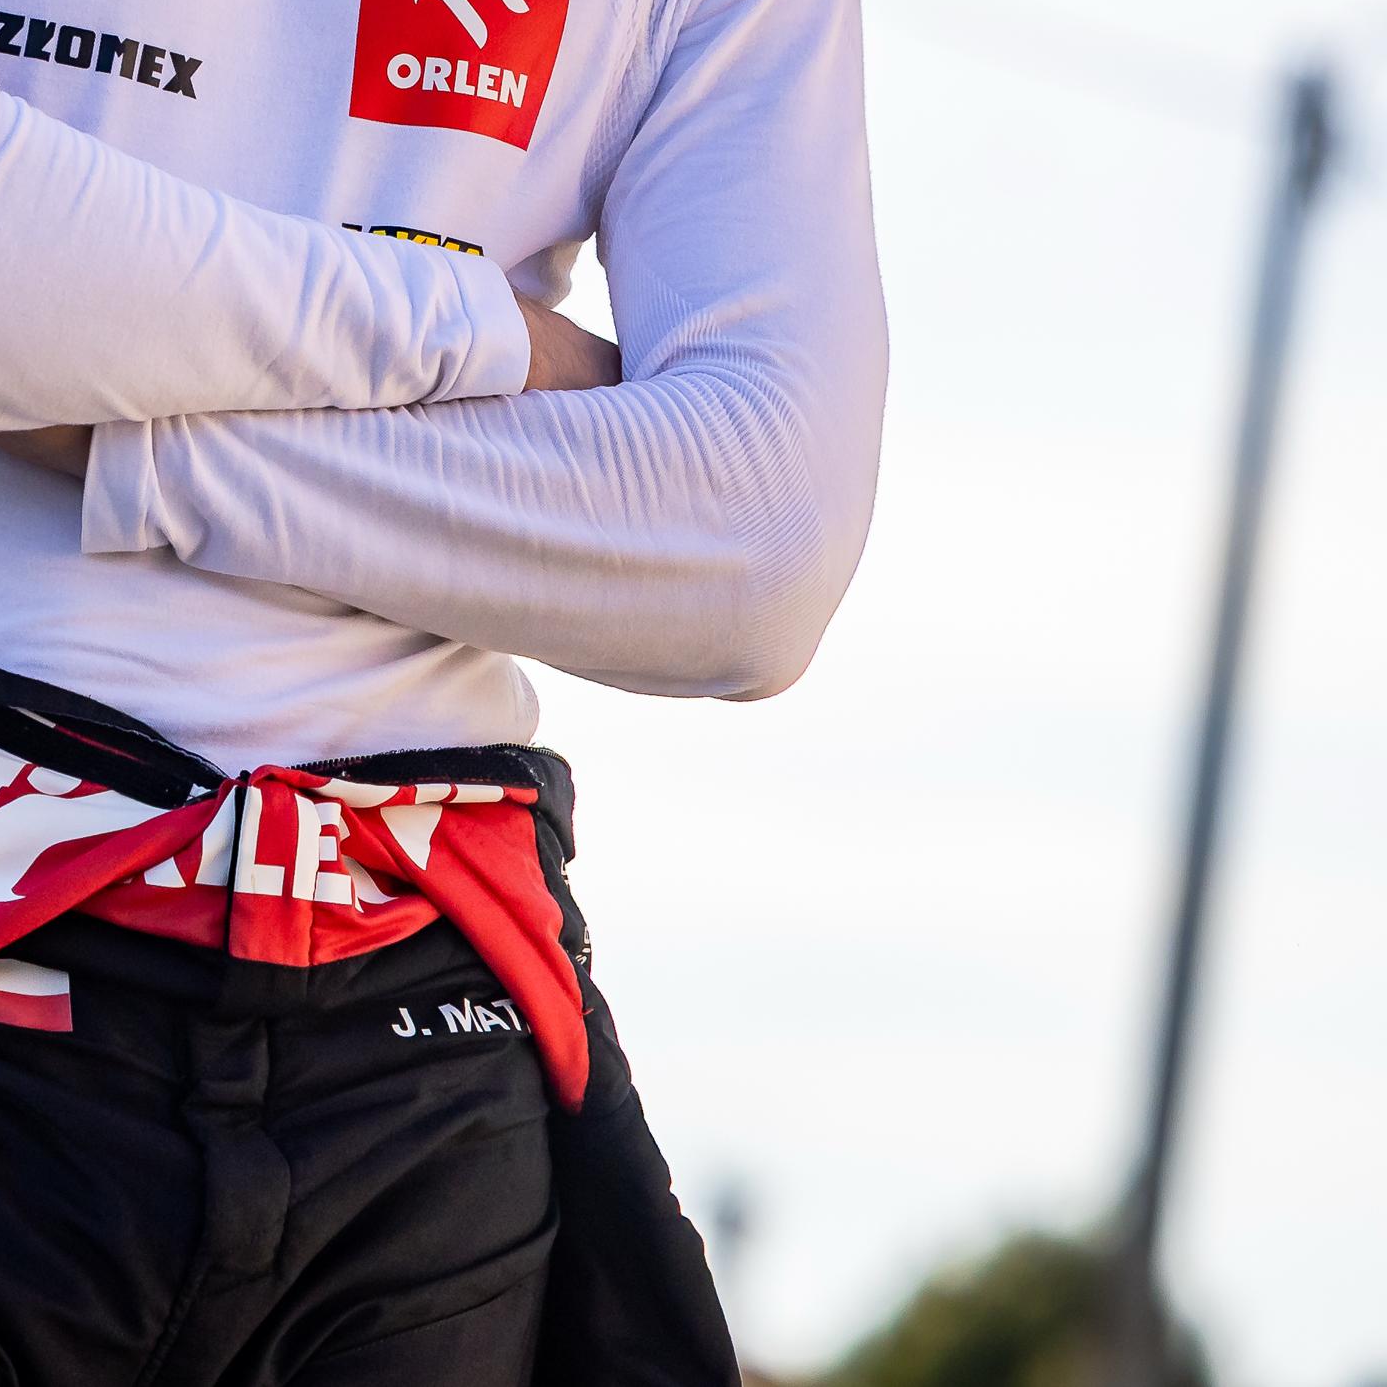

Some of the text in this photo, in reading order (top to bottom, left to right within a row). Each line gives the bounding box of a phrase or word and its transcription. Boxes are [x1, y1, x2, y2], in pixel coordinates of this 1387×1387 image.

[386, 53, 528, 109] ORLEN
[391, 998, 533, 1038] J. MAT
